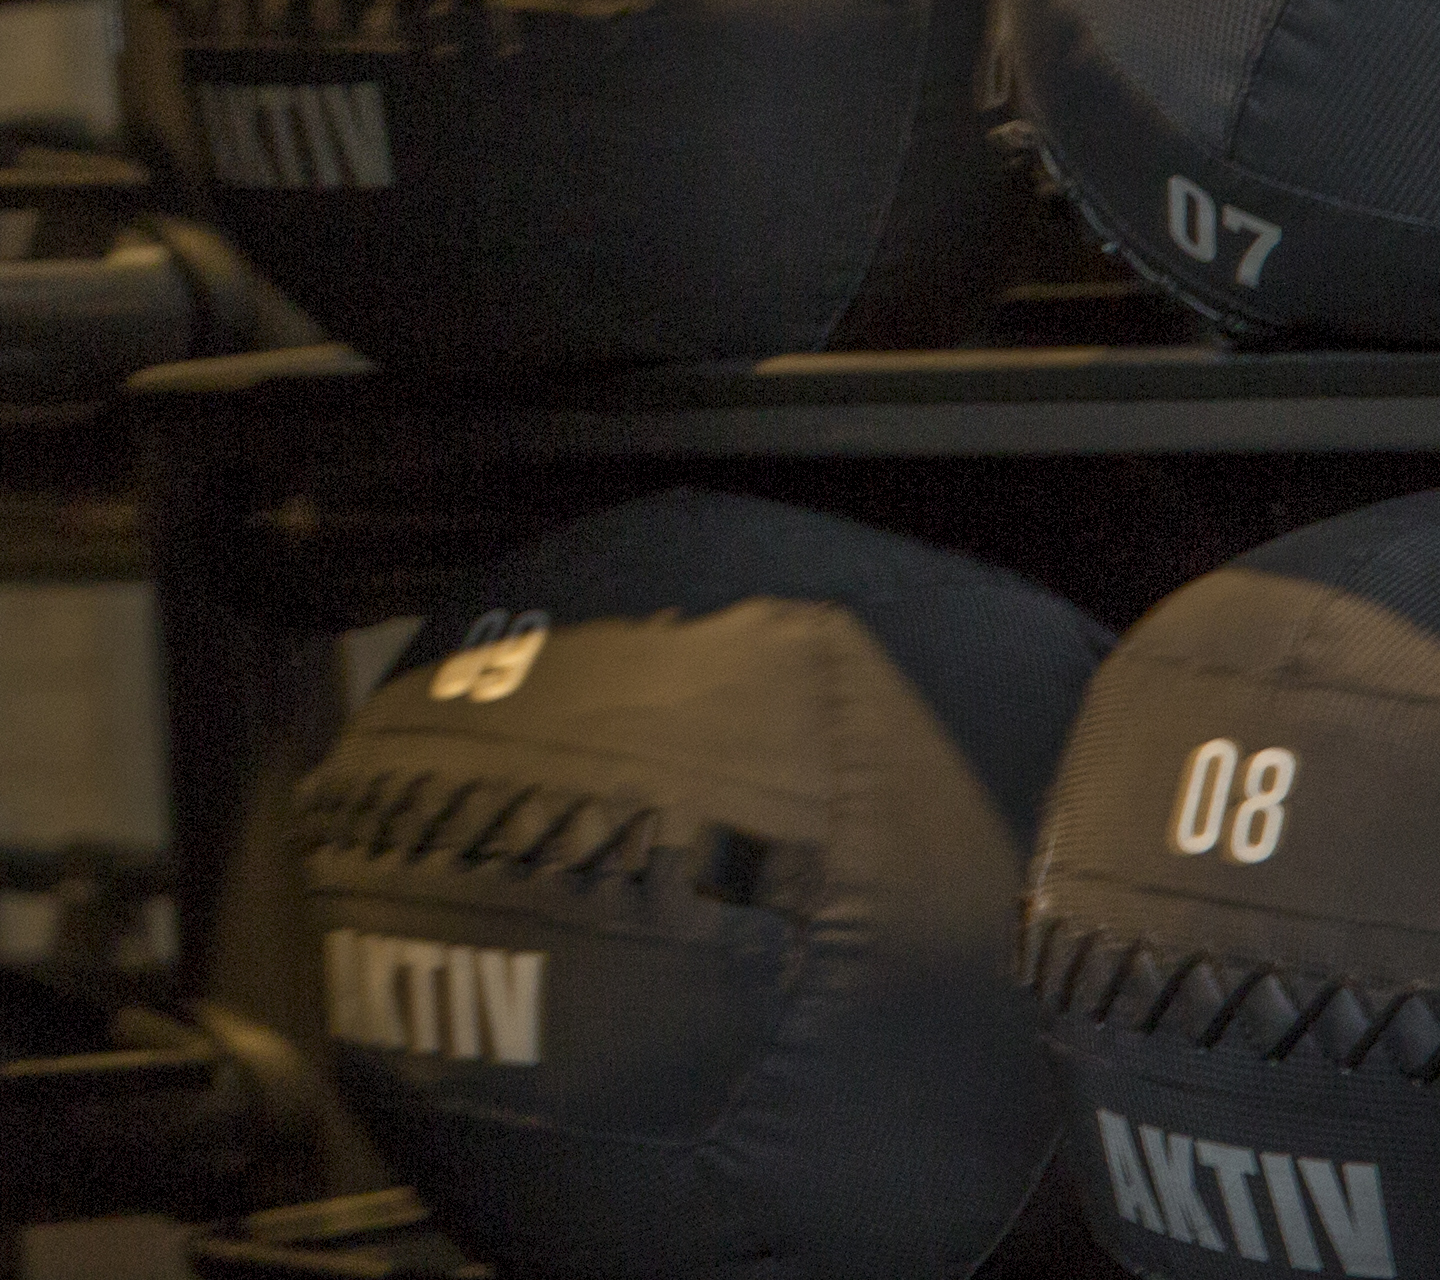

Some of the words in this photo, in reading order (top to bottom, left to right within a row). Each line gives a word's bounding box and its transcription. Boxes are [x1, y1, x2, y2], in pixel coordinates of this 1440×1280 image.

[1166, 173, 1282, 290] 07
[1174, 736, 1297, 864] 08
[1095, 1107, 1397, 1279] AKTIV
